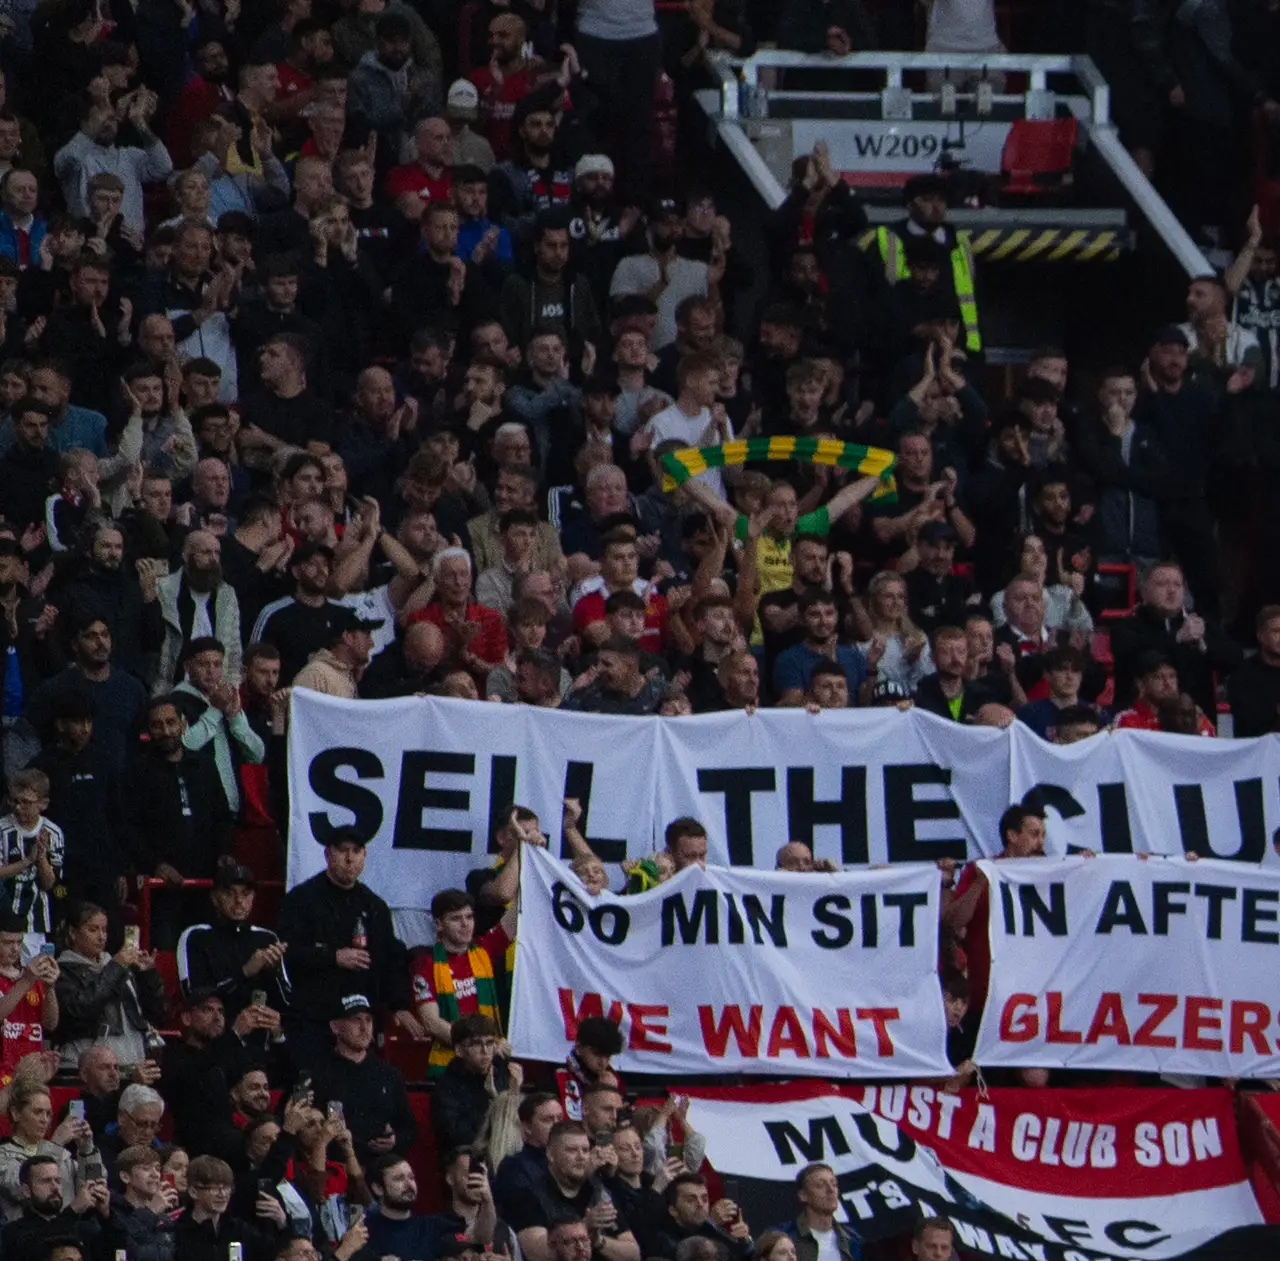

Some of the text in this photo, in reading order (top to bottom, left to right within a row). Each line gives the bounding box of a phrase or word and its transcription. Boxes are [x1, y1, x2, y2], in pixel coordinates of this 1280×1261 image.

[854, 134, 938, 159] W209
[308, 747, 627, 863] SELL
[696, 764, 968, 867] THE
[552, 881, 631, 947] 60
[661, 889, 788, 949] MIN
[811, 892, 929, 950] SIT
[1000, 881, 1068, 938] IN
[558, 987, 673, 1056] WE
[697, 1004, 900, 1059] WANT
[861, 1084, 1223, 1169] JUST A CLUB SON
